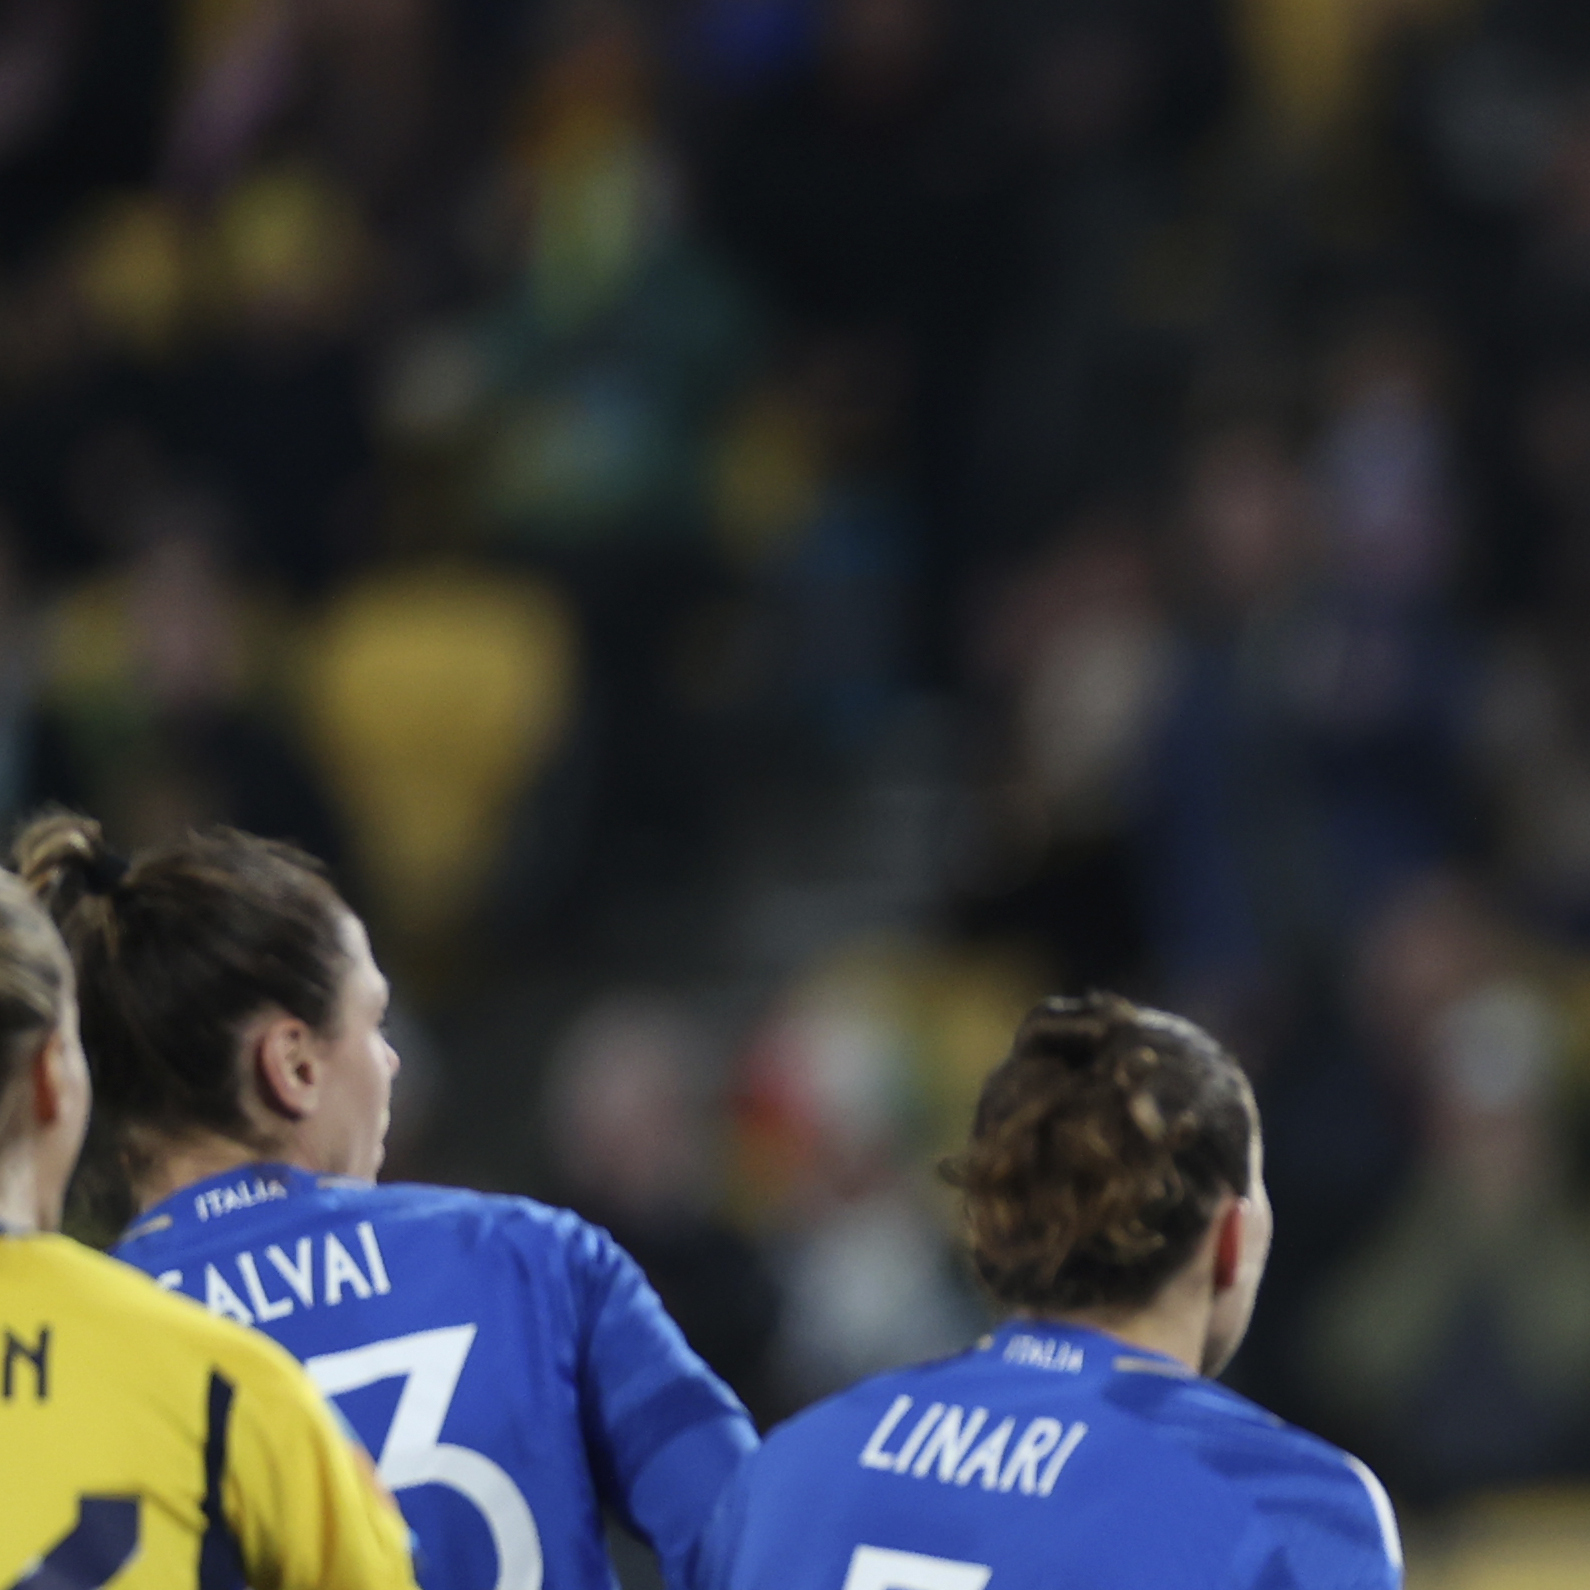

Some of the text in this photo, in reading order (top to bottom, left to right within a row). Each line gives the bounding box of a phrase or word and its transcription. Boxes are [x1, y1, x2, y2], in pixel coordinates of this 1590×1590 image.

[194, 1179, 288, 1222] ITALIA
[1003, 1334, 1085, 1373] ITALIA
[860, 1395, 1087, 1498] LINARI
